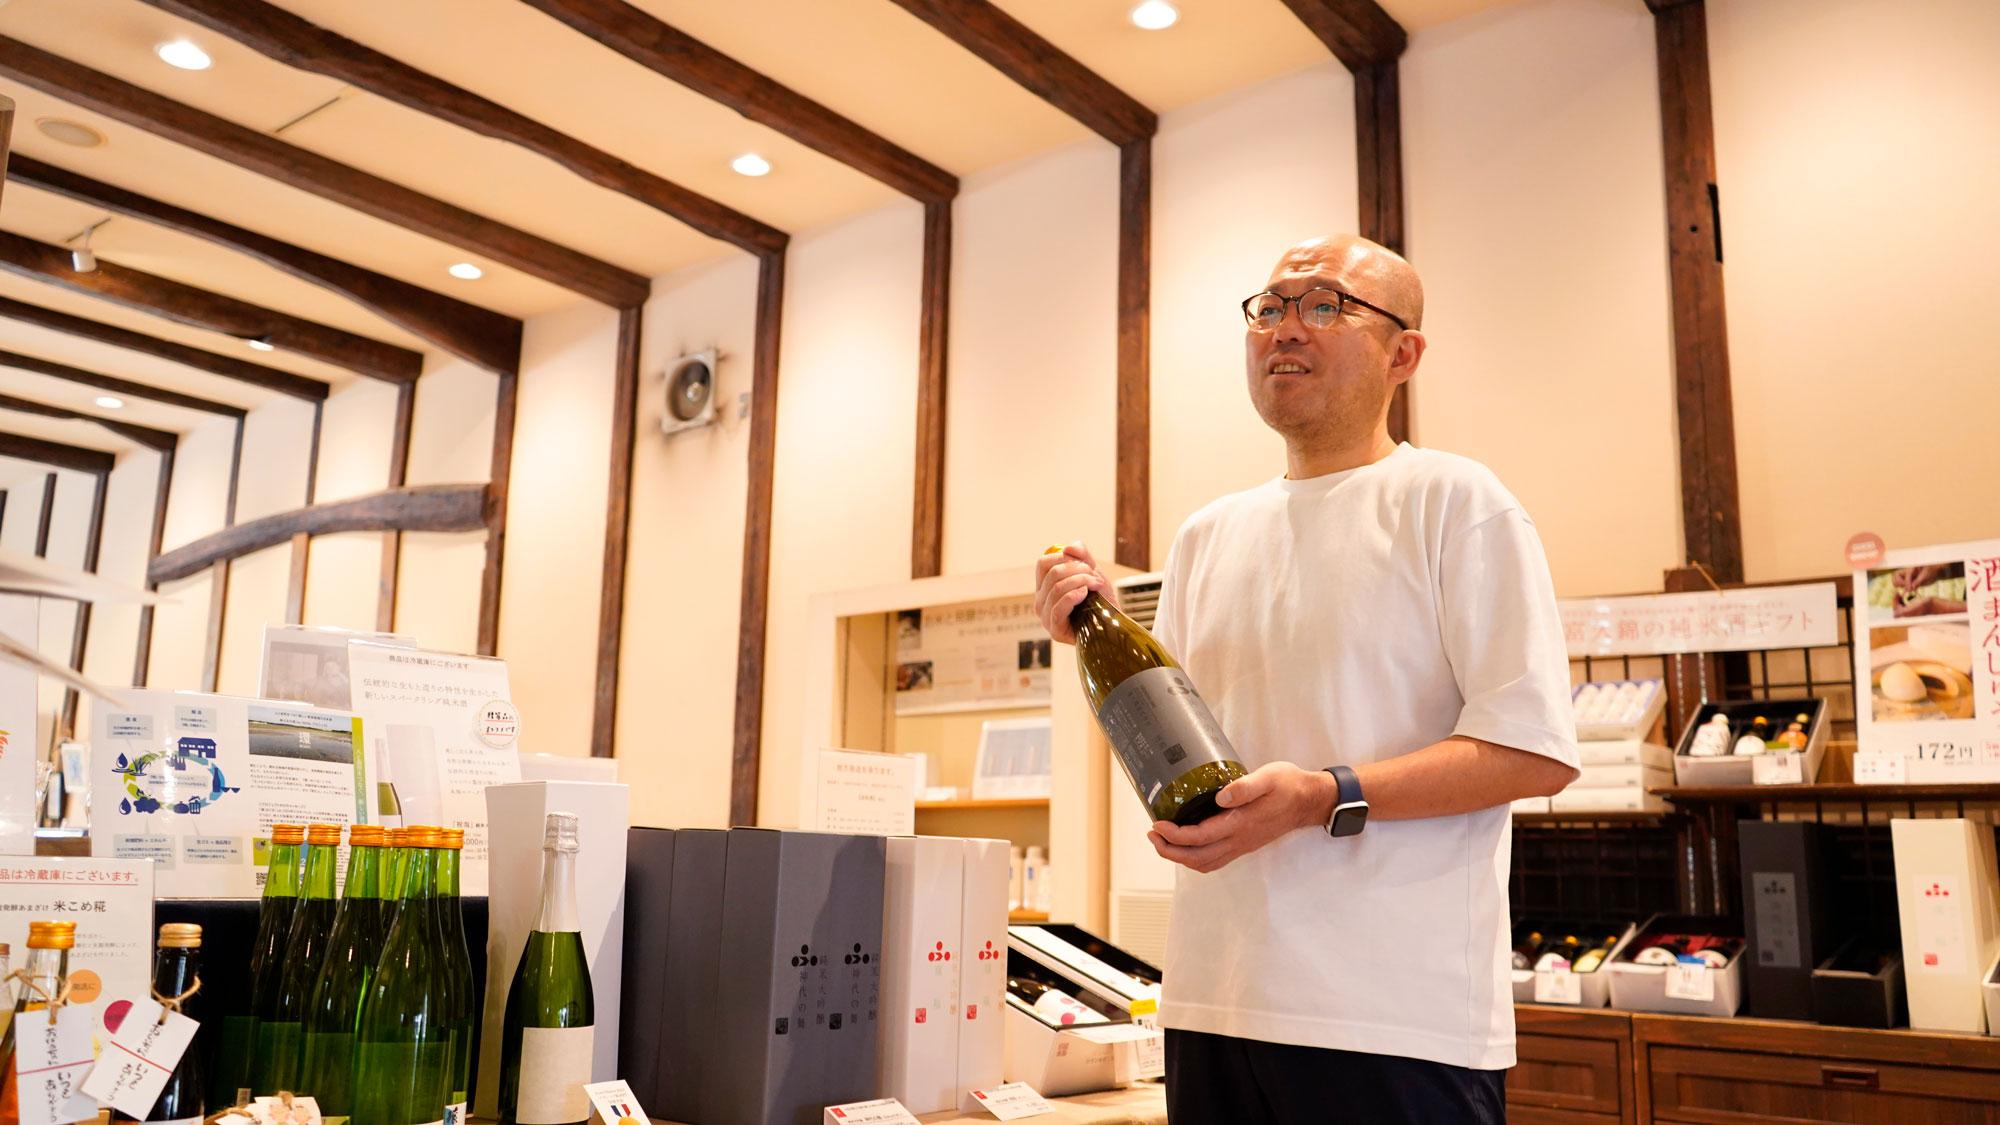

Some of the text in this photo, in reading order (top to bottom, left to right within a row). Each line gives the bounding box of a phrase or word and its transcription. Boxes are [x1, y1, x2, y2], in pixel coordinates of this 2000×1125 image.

[389, 655, 470, 671] 商品は冷蔵庫にございます
[0, 900, 107, 913] 発酵あまざけ 米こめ糀
[57, 1072, 72, 1100] いつも
[128, 1063, 149, 1091] いつも
